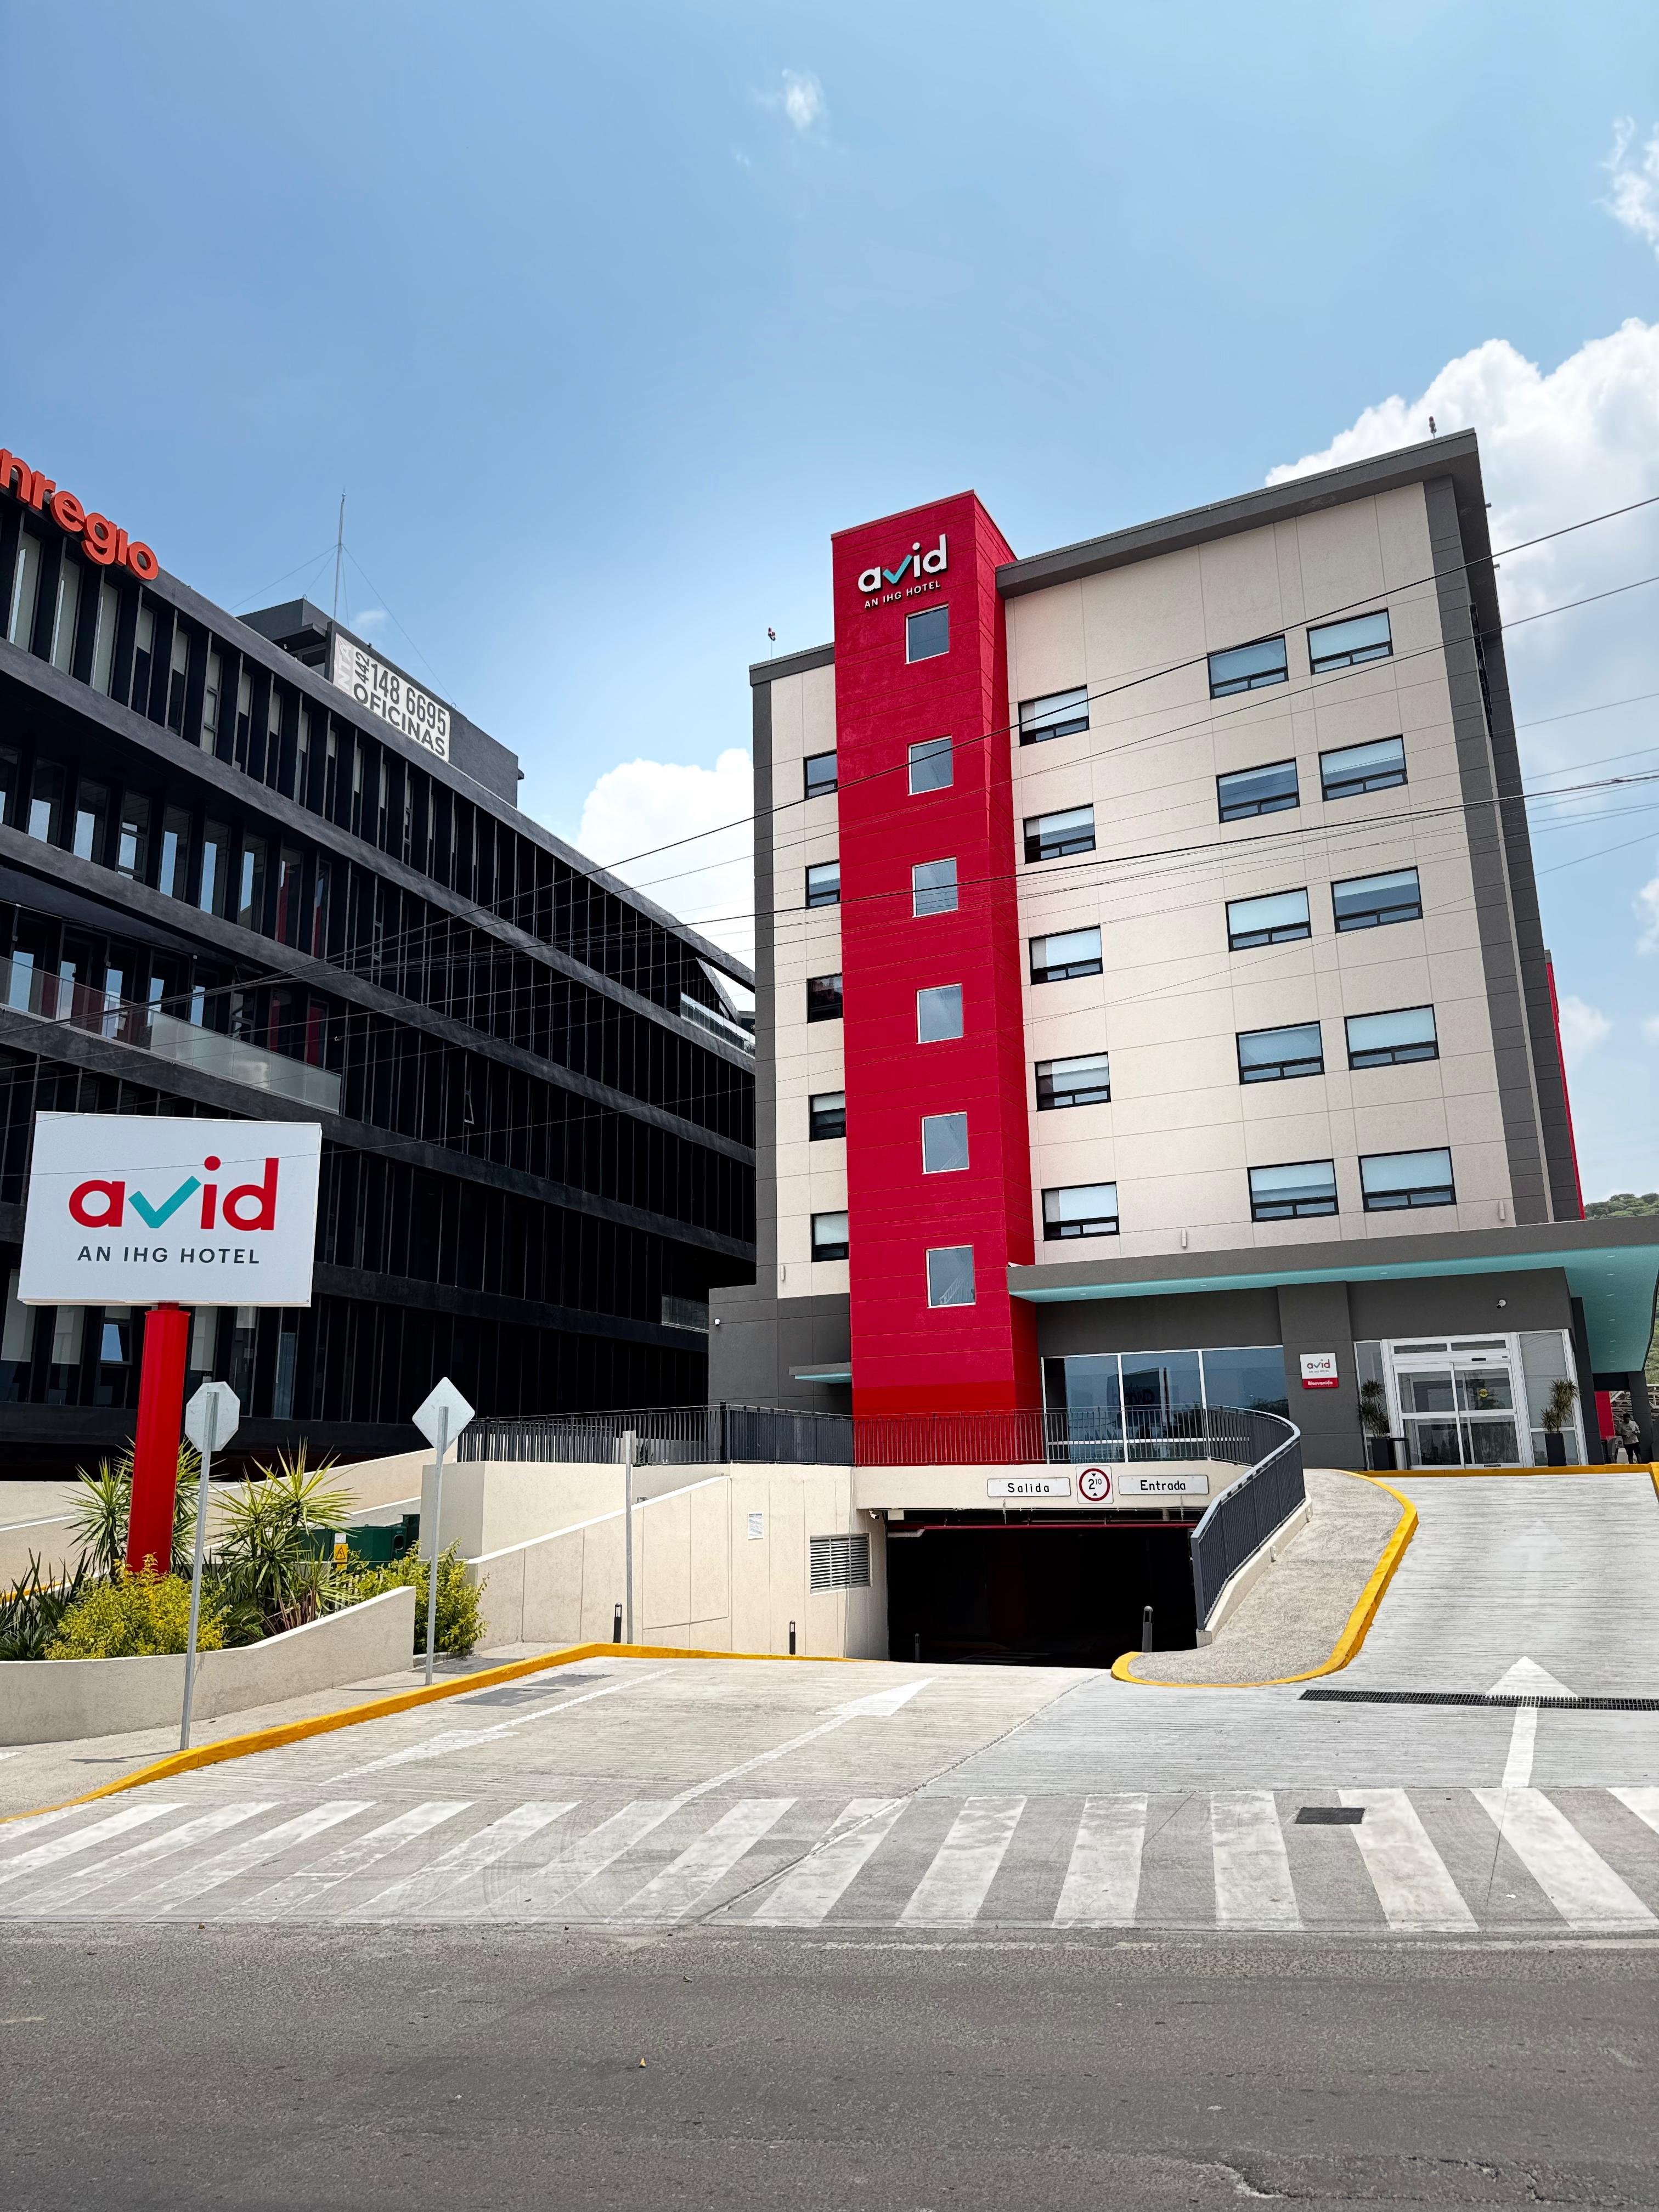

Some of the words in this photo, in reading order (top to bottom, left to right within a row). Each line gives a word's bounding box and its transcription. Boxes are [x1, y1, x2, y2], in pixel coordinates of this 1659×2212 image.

[857, 533, 947, 592] avid
[865, 597, 878, 609] AN
[883, 591, 901, 603] IHG
[906, 580, 941, 596] HOTEL
[355, 651, 370, 685] 442
[371, 664, 400, 705] 148
[406, 687, 446, 737] 6695
[353, 683, 445, 757] OFICINAS
[69, 1155, 279, 1231] avid
[77, 1245, 111, 1261] AN
[123, 1246, 168, 1263] IHG
[180, 1248, 259, 1264] HOTEL
[1307, 1358, 1330, 1369] avid
[1007, 1482, 1050, 1493] Salida
[1141, 1480, 1186, 1492] Entrada
